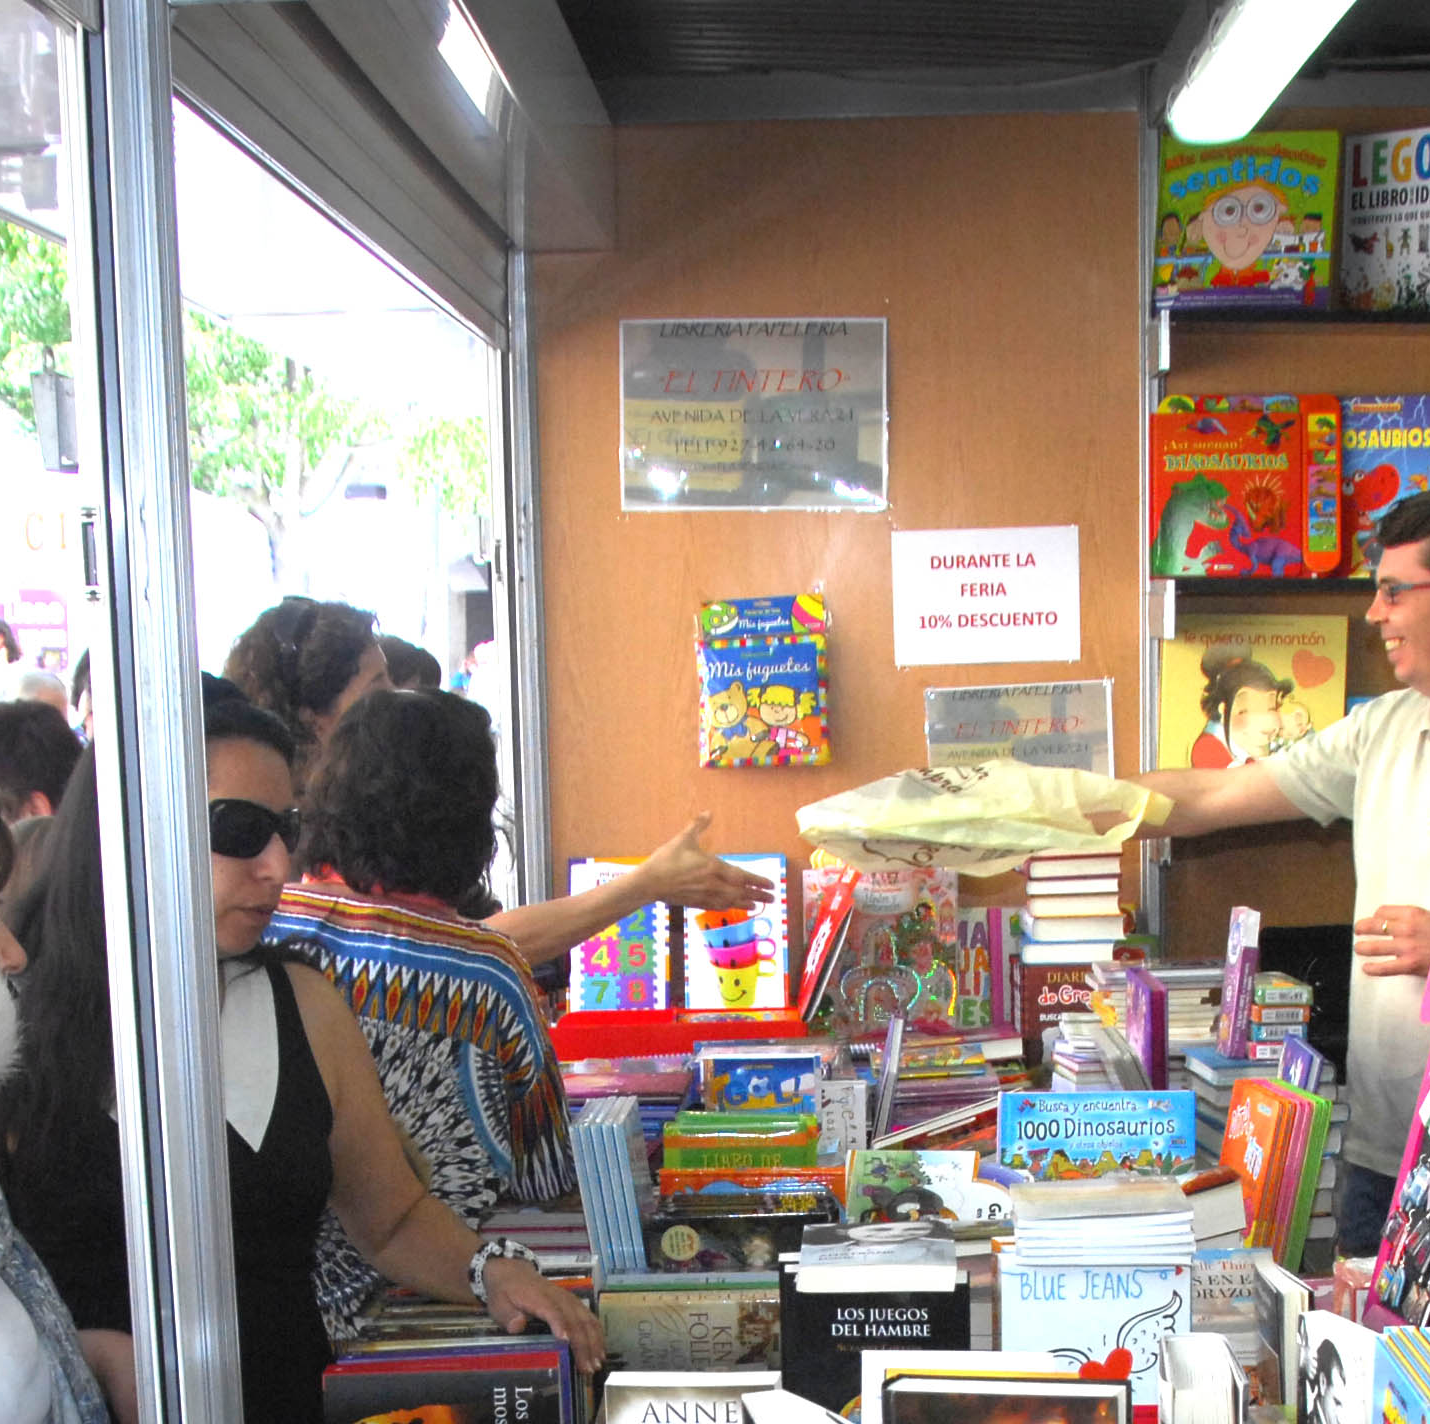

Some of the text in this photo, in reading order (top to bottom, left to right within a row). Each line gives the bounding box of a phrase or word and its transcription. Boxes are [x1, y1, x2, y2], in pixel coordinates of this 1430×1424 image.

[1169, 156, 1321, 198] sentidos
[1351, 190, 1367, 211] EL
[1368, 186, 1409, 210] LIBRO
[929, 552, 1037, 571] DURANTE LA
[959, 582, 1007, 598] FERIA
[918, 609, 1059, 630] 10% DESCUENTO
[1199, 628, 1326, 652] quiero un montón
[706, 655, 812, 684] Mis juguetes
[626, 908, 647, 932] 2
[590, 943, 648, 968] 4 5
[590, 978, 647, 1004] 7 8
[1037, 988, 1058, 1005] de
[1037, 1098, 1069, 1113] Busca
[1083, 1098, 1138, 1113] encuentra
[1017, 1117, 1176, 1142] 1000 Dinosaurios
[1019, 1269, 1145, 1301] BLUE JEANS
[836, 1306, 929, 1324] LOS JUEGOS
[831, 1322, 932, 1338] DEL HAMBRE
[711, 1324, 733, 1363] KEN
[513, 1385, 533, 1414] Los
[641, 1400, 740, 1424] ANNE
